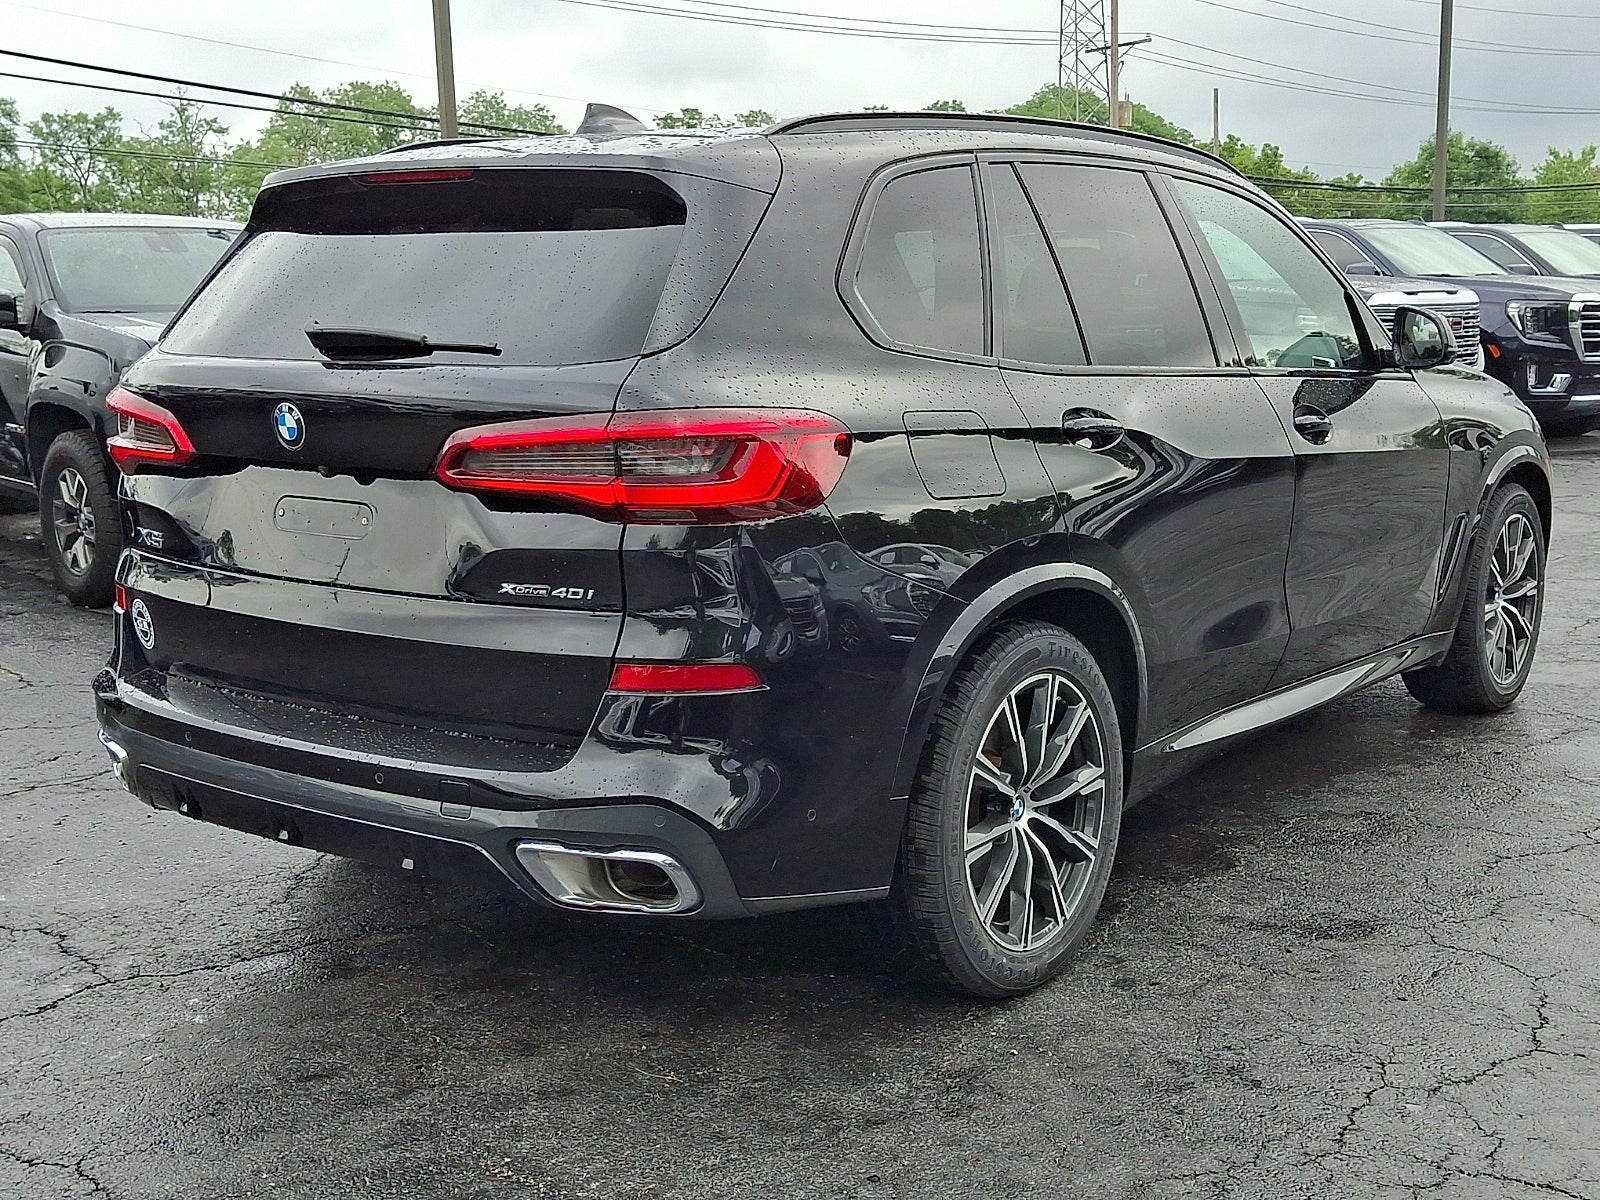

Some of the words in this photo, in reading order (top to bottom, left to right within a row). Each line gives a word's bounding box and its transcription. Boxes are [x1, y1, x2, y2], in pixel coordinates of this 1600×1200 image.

[136, 526, 164, 549] X5
[551, 587, 595, 600] 40i
[1048, 641, 1113, 716] Firestone
